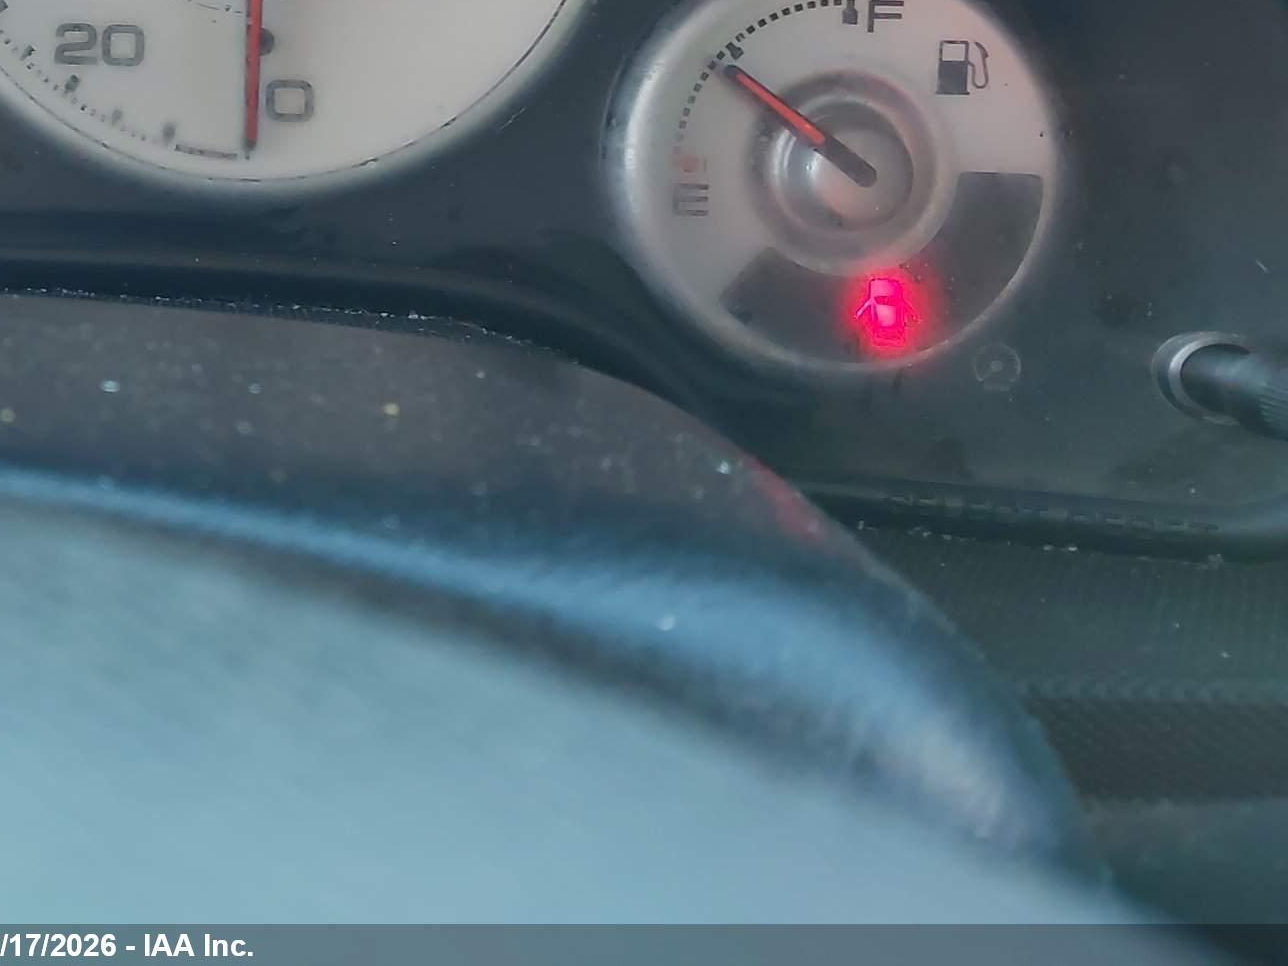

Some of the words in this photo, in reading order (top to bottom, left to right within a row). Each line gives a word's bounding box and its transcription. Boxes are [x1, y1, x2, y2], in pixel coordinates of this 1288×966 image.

[867, 0, 905, 33] F
[54, 22, 145, 66] 20
[265, 79, 314, 123] 0
[673, 183, 709, 218] E
